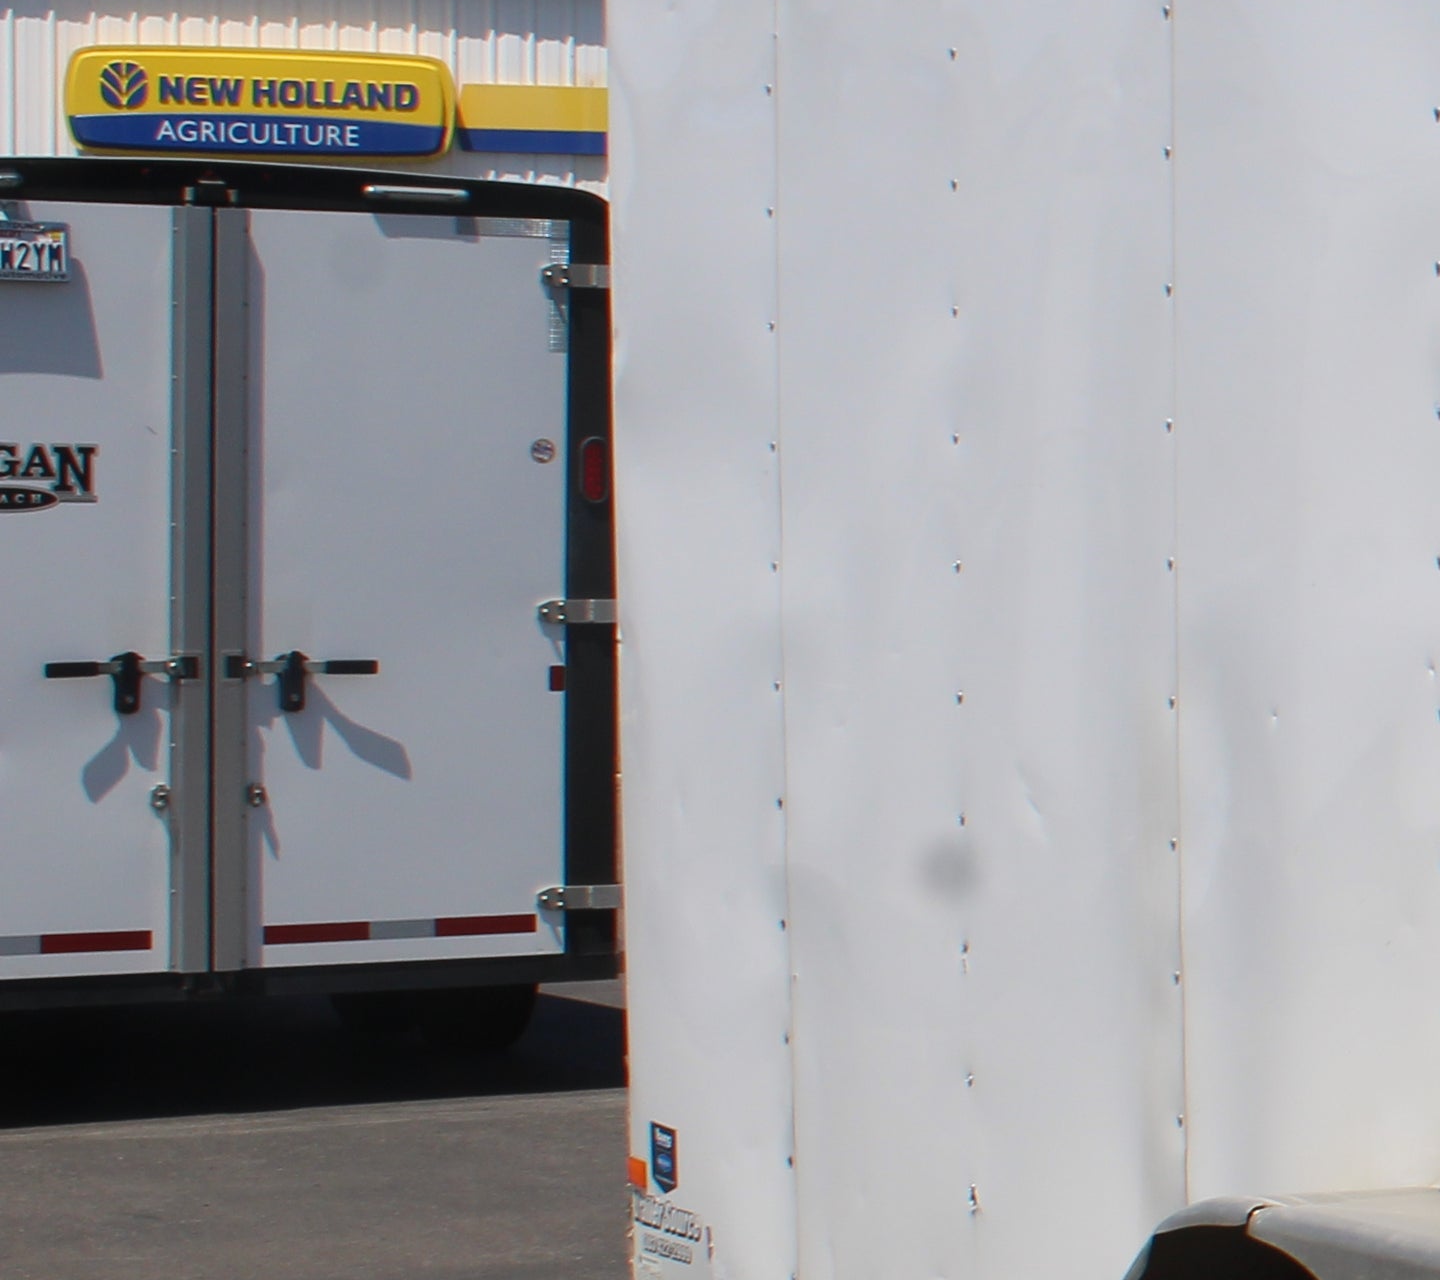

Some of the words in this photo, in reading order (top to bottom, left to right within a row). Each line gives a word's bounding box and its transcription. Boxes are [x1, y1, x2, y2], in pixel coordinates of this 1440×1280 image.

[159, 73, 244, 109] NEW
[251, 78, 421, 112] HOLLAND
[156, 120, 360, 148] AGRICULTURE
